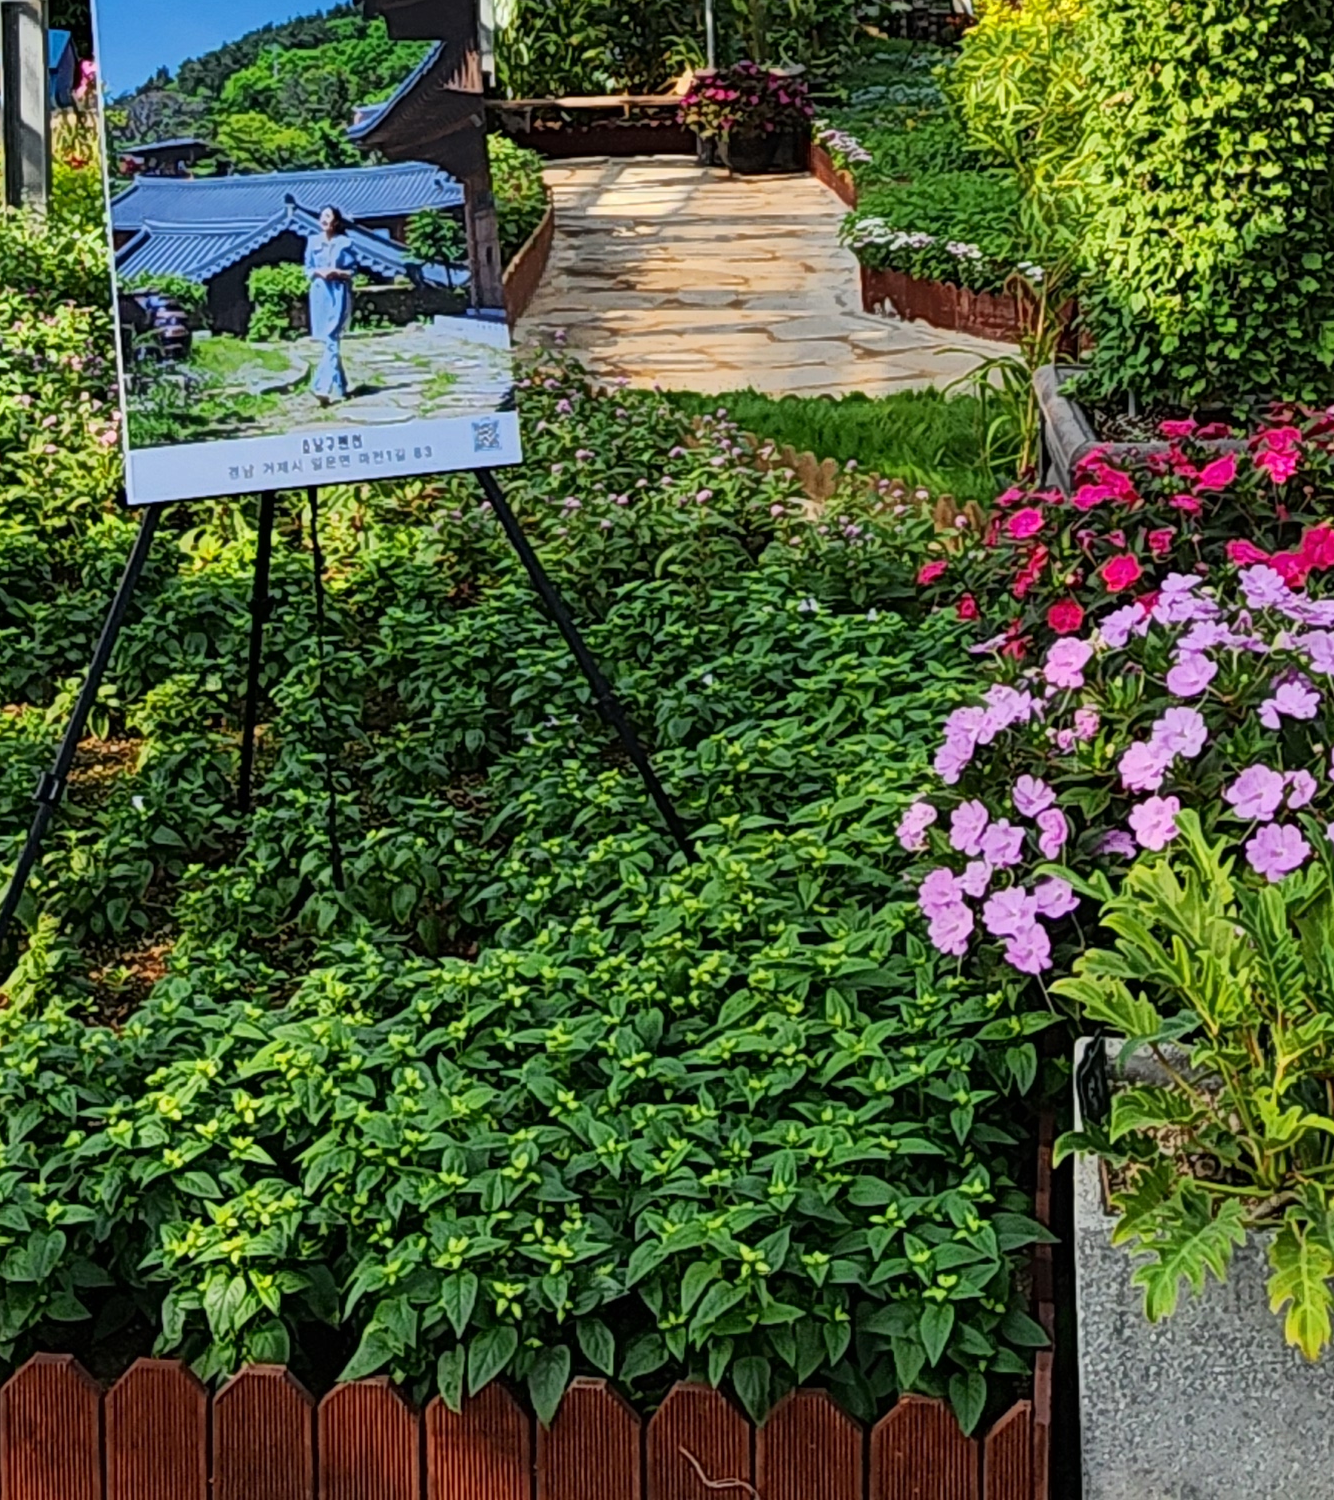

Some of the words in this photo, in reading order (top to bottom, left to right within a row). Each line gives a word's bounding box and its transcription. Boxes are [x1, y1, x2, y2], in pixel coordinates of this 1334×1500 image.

[228, 464, 254, 480] 경남
[262, 458, 304, 475] 거제시
[311, 453, 351, 471] 일운면
